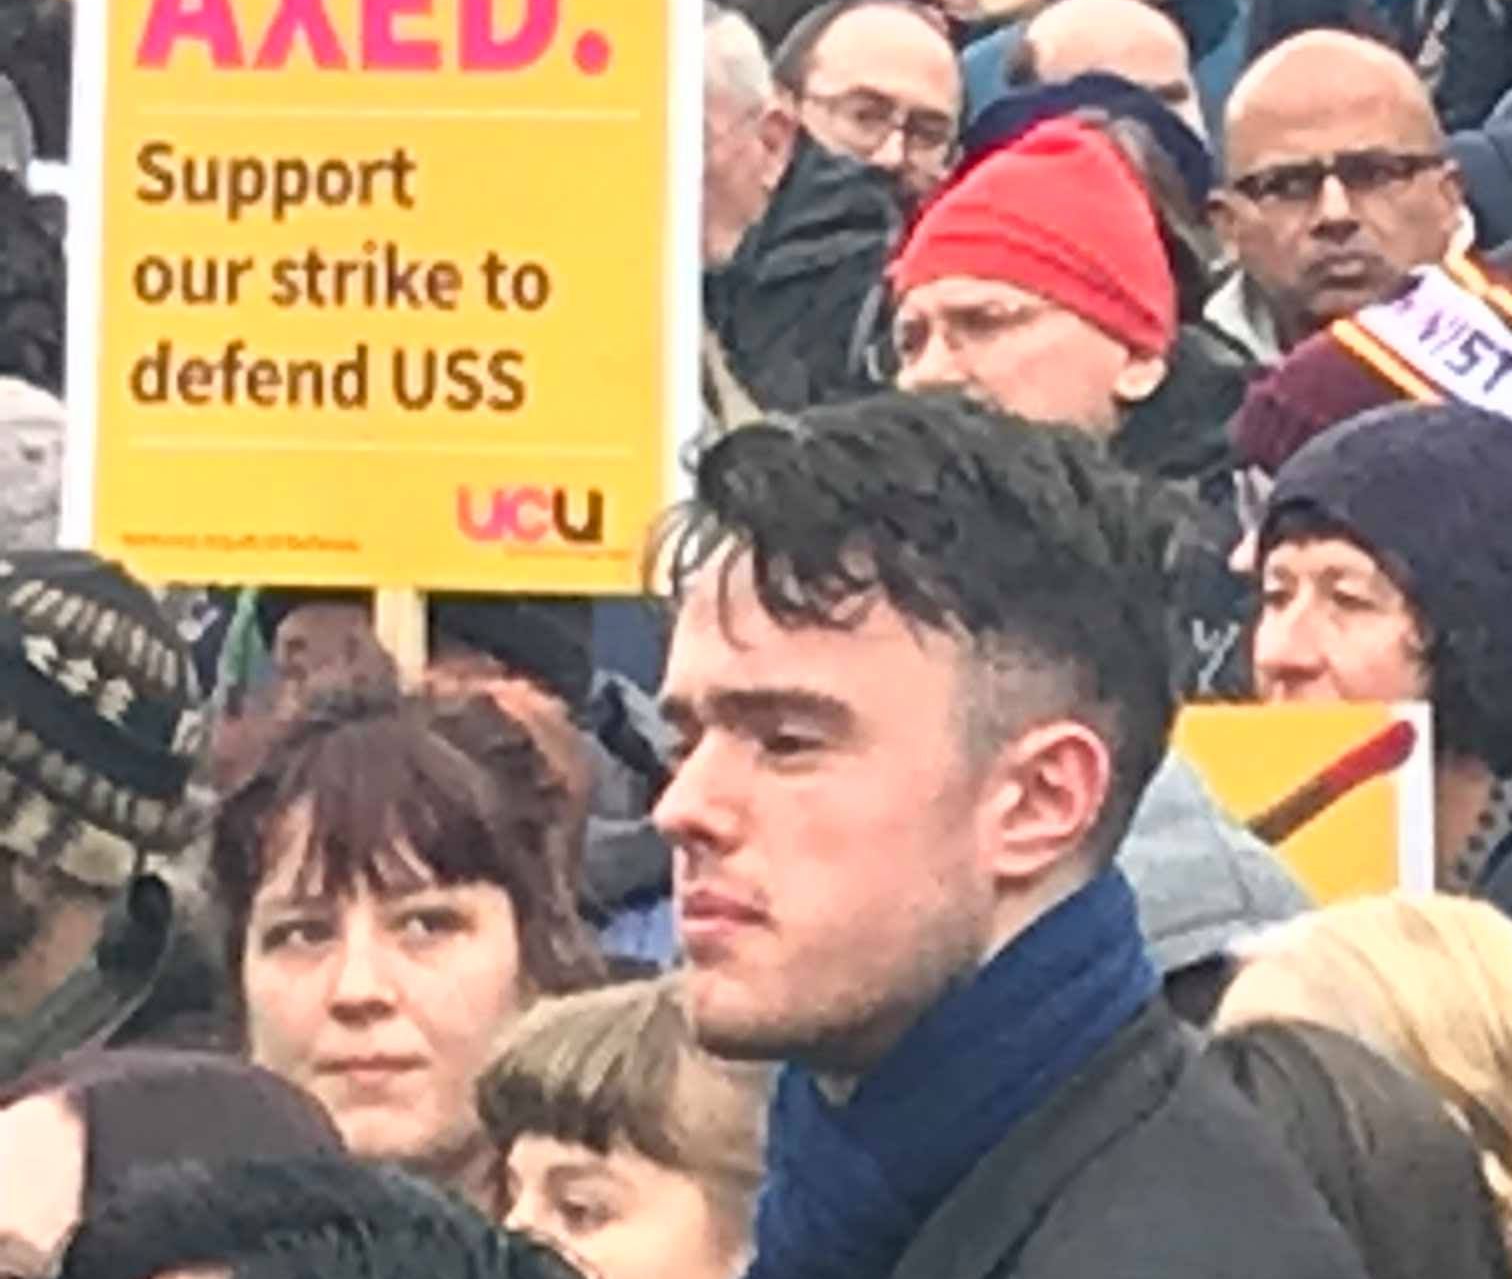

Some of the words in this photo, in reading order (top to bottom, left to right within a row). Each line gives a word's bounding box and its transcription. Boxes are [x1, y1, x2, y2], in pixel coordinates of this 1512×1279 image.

[135, 141, 418, 222] Support
[133, 254, 253, 306] our
[270, 240, 464, 311] strike
[480, 251, 552, 313] to
[130, 340, 369, 411] defend
[392, 347, 527, 414] USS
